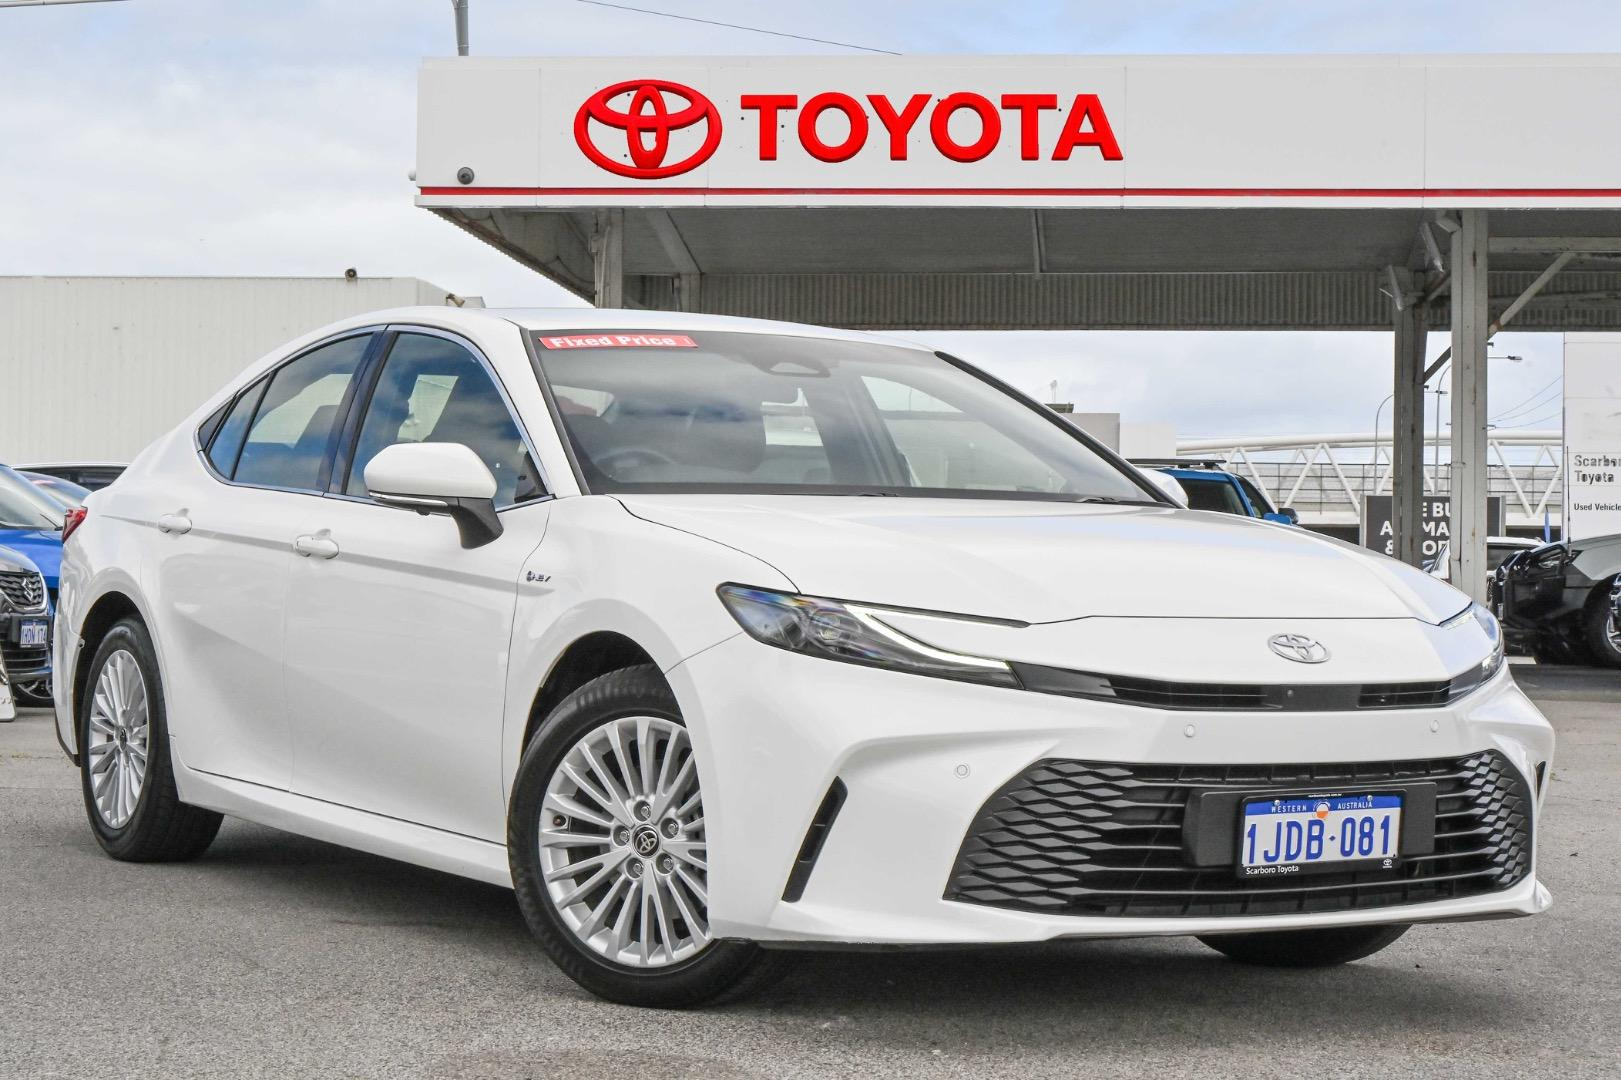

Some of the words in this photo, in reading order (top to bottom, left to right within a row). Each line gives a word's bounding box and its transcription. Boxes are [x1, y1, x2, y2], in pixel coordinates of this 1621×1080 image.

[741, 91, 1124, 163] TOYOTA
[549, 336, 614, 347] Fixed
[615, 335, 677, 346] Price
[1574, 470, 1614, 485] Toyota
[1574, 503, 1592, 511] Used
[1271, 805, 1307, 813] WESTERN
[1337, 801, 1373, 810] AUSTRALIA
[1246, 866, 1276, 875] Scarboro
[1277, 865, 1299, 874] Toyota
